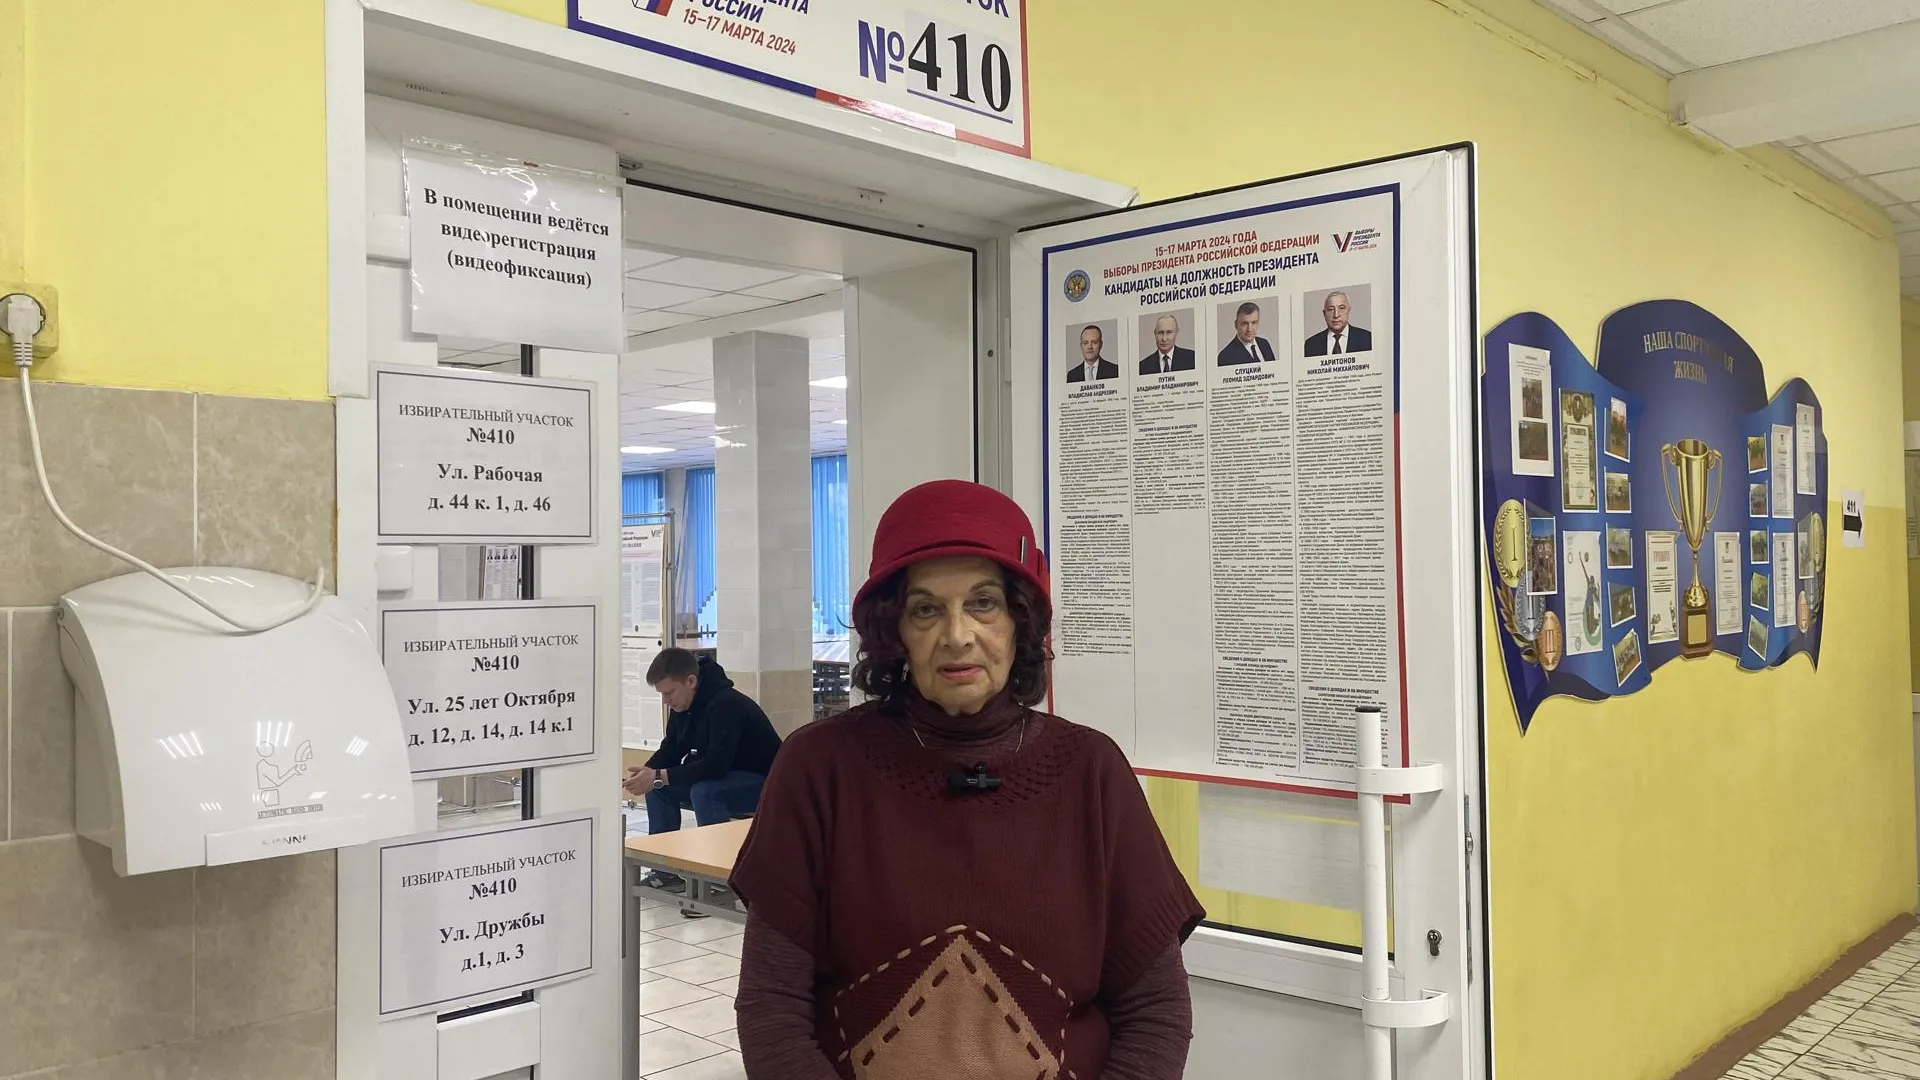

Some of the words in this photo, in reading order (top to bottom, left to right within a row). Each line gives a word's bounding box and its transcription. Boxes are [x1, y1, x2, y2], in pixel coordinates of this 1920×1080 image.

[688, 0, 764, 23] ССИИ
[721, 19, 765, 46] МАРТА
[766, 34, 796, 55] 2024
[424, 187, 437, 204] В
[443, 195, 542, 225] помещении
[548, 213, 609, 236] ведётся
[441, 222, 596, 261] видеорегистрация
[1155, 245, 1175, 257] 15-17
[1177, 239, 1207, 253] МАРТА
[1209, 235, 1230, 248] 2024
[1232, 230, 1257, 243] ГОДА
[1103, 265, 1139, 278] ВЫБОРЫ
[1141, 255, 1195, 272] ПРЕЗИДЕНТА
[1197, 241, 1258, 263] РОССИЙСКОЙ
[1260, 234, 1320, 253] ФЕДЕРАЦИИ
[447, 249, 592, 289] (видеофиксация)
[1104, 276, 1162, 296] КАНДИДАТЫ
[1165, 274, 1178, 286] НА
[1180, 263, 1245, 284] ДОЛЖНОСТЬ
[1248, 252, 1319, 273] ПРЕЗИДЕНТА
[1140, 283, 1207, 306] РОССИЙСКОЙ
[1209, 275, 1276, 296] ФЕДЕРАЦИИ
[1643, 331, 1673, 353] НАША
[1234, 366, 1262, 375] СЛУЦКИЙ
[1306, 366, 1332, 376] НИКОЛАЙ
[1332, 363, 1370, 373] МИХАЙЛОВИЧ
[1320, 356, 1356, 367] ХАРИТОНОВ
[1674, 360, 1708, 384] ЖИЗНЬ
[1080, 383, 1105, 392] ДАВАНКОВ
[1136, 384, 1161, 393] ВЛАДИМИР
[1161, 380, 1199, 390] ВЛАДИМИРОВИЧ
[1243, 373, 1275, 383] ЭДУАРДОВИЧ
[399, 404, 513, 422] ИЗБИРАТЕЛЬНЫЙ
[517, 413, 574, 427] УЧАСТОК
[466, 427, 515, 444] №410
[438, 463, 468, 480] Ул.
[474, 465, 543, 482] Рабочая
[428, 497, 444, 510] д.
[449, 494, 469, 510] 44
[475, 499, 490, 510] к.
[496, 495, 509, 513] 1,
[513, 499, 528, 511] д.
[533, 497, 551, 511] 46
[1846, 500, 1856, 513] 411
[404, 635, 518, 653] ИЗБИРАТЕЛЬНЫЙ
[521, 635, 579, 648] УЧАСТОК
[471, 655, 520, 672] №410
[407, 698, 439, 715] Ул.
[444, 696, 465, 712] 25
[469, 696, 500, 711] лет
[504, 689, 576, 708] Октября
[408, 733, 425, 747] д.
[431, 727, 456, 746] 12,
[460, 730, 476, 743] д.
[481, 723, 505, 740] 14,
[509, 726, 524, 738] д.
[528, 719, 546, 735] 14
[402, 857, 516, 887] ИЗБИРАТЕЛЬНЫЙ
[518, 849, 576, 868] УЧАСТОК
[469, 877, 517, 900] №410
[439, 927, 470, 944] Ул.
[474, 912, 545, 941] Дружбы
[461, 951, 491, 972] д.1,
[495, 949, 511, 964] д.
[515, 943, 524, 959] 3
